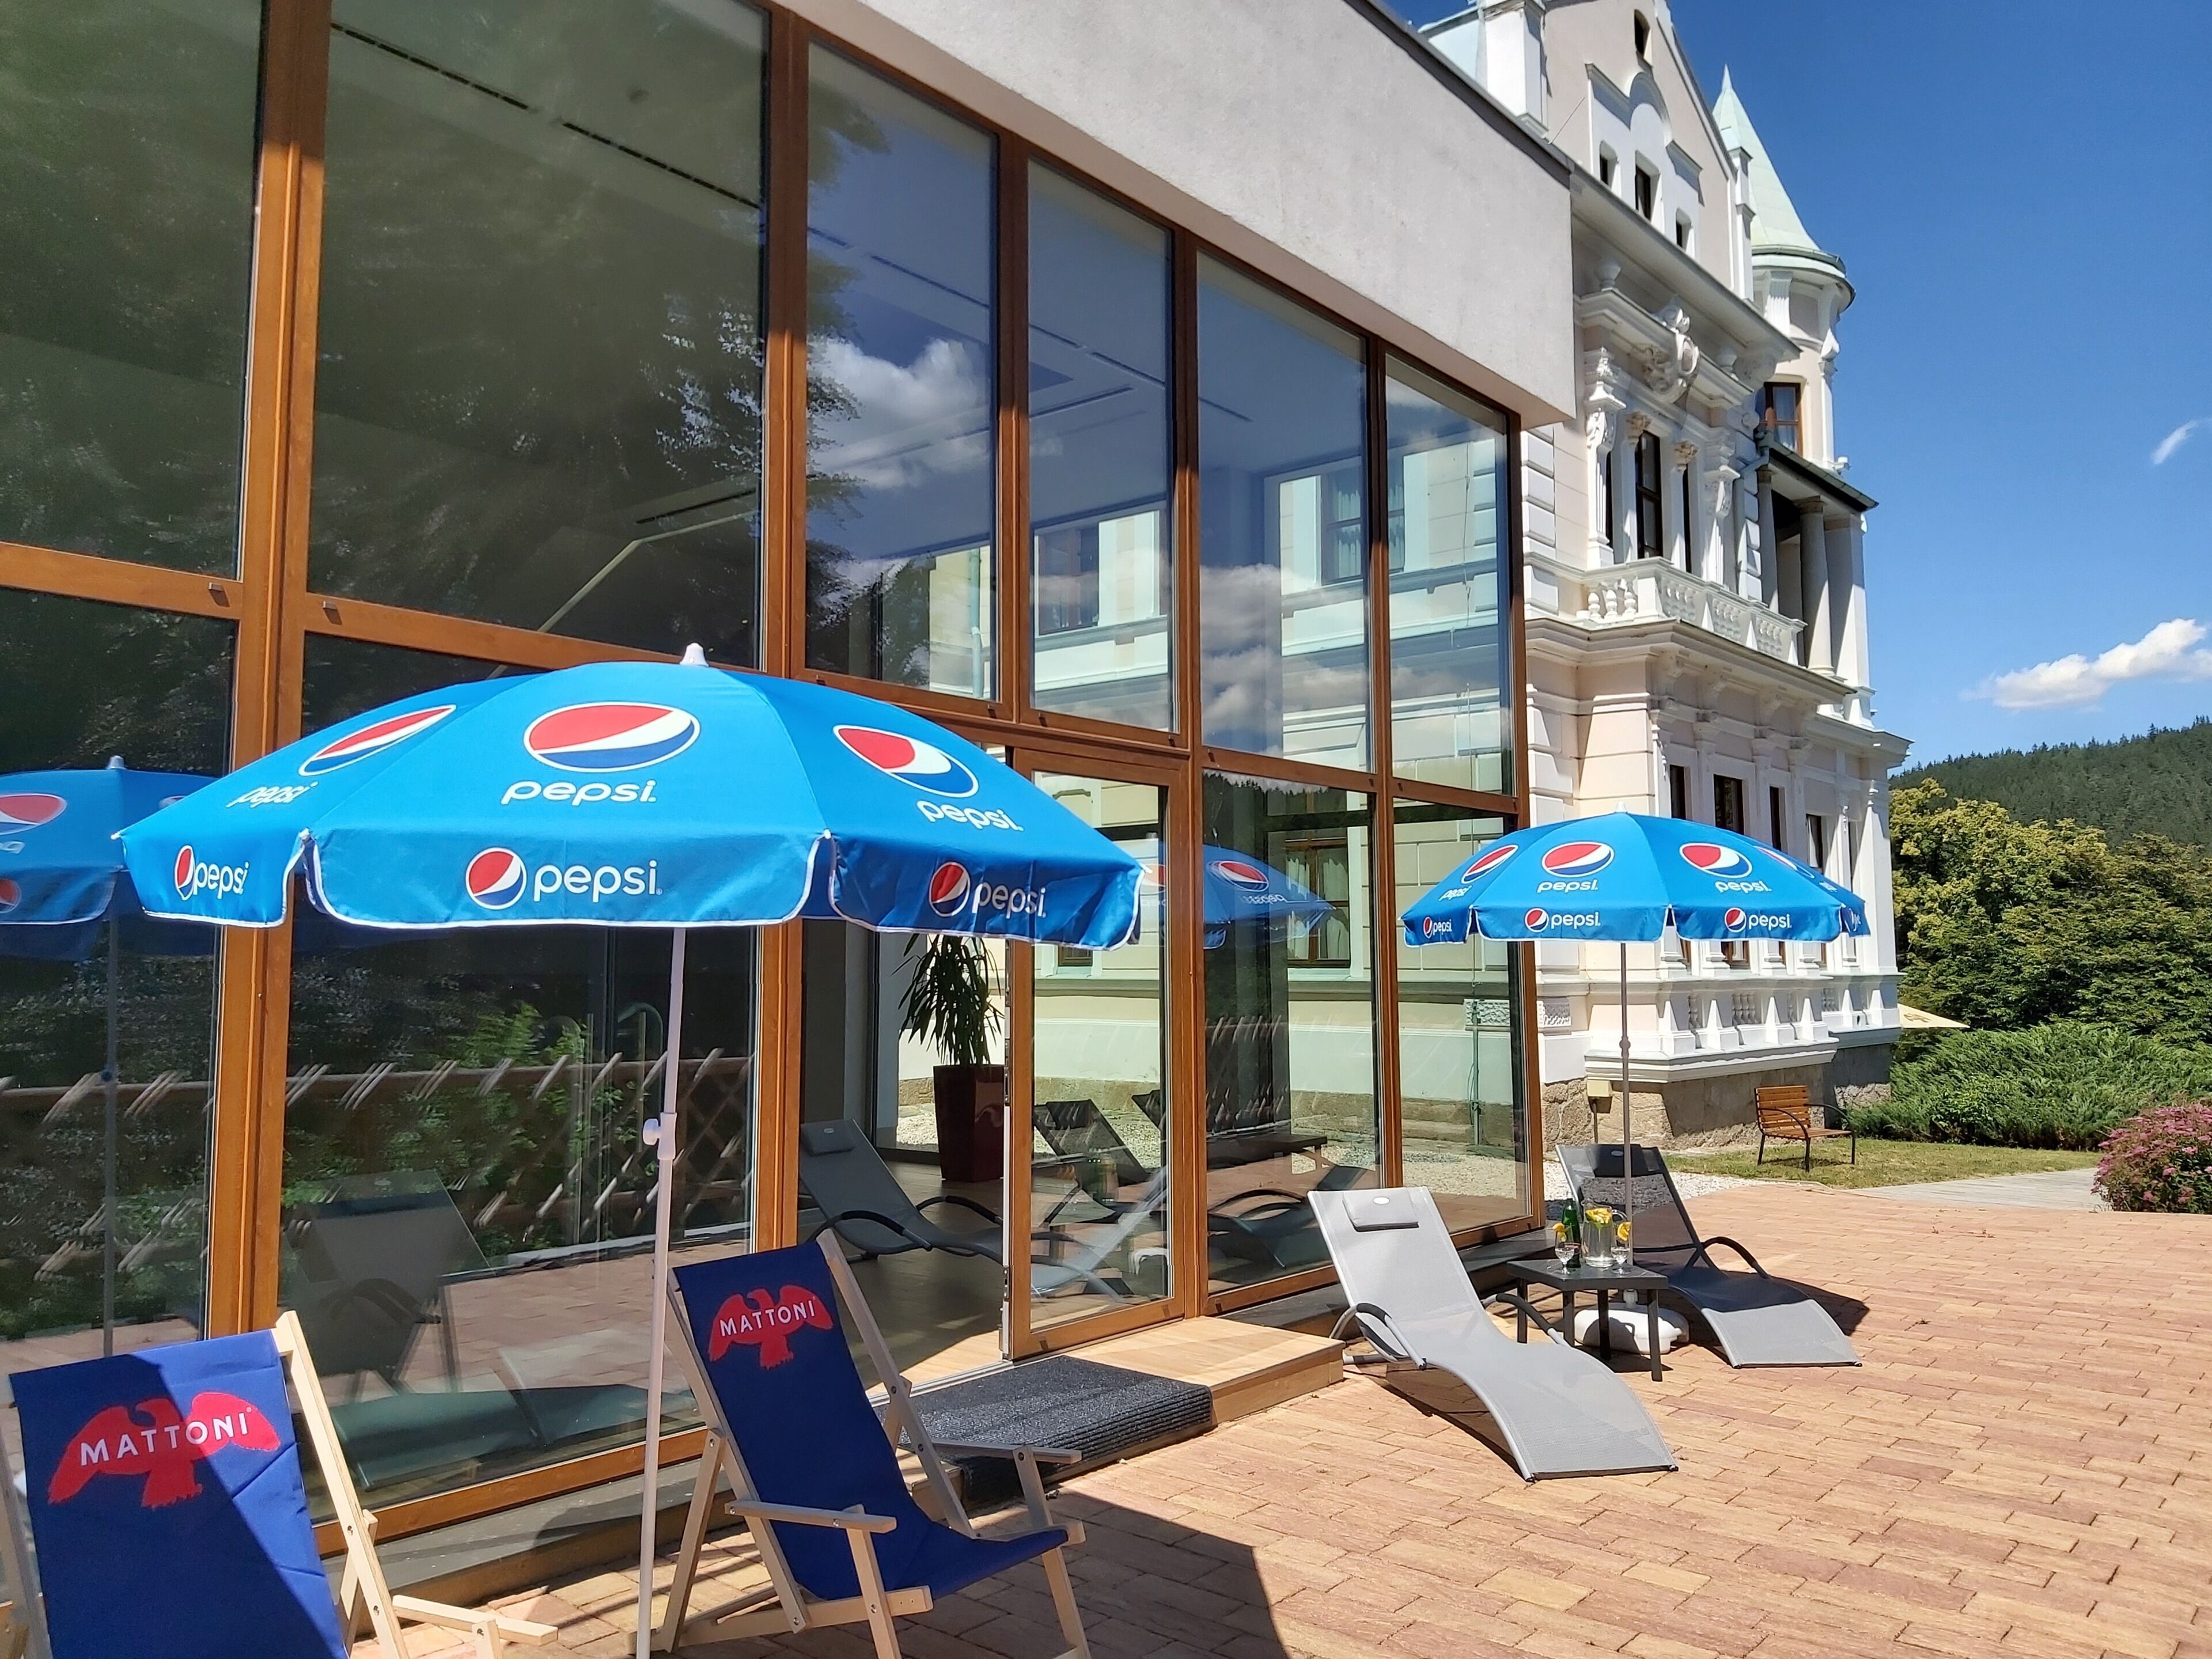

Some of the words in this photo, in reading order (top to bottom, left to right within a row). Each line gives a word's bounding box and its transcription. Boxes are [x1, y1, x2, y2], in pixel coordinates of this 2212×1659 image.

[226, 781, 318, 808] pepsi
[501, 780, 656, 806] pepsi
[916, 797, 1021, 831] pepsi
[193, 862, 249, 899] pepsi
[533, 860, 657, 903] pepsi
[1537, 879, 1598, 893] pepsi
[1715, 880, 1770, 893] pepsi
[972, 887, 1046, 919] pepsi
[1433, 919, 1452, 935] pepsi
[1551, 911, 1599, 930] pepsi
[1749, 914, 1790, 931] pepsi
[720, 1300, 816, 1337] MATTONI
[81, 1412, 249, 1466] MATTONI
